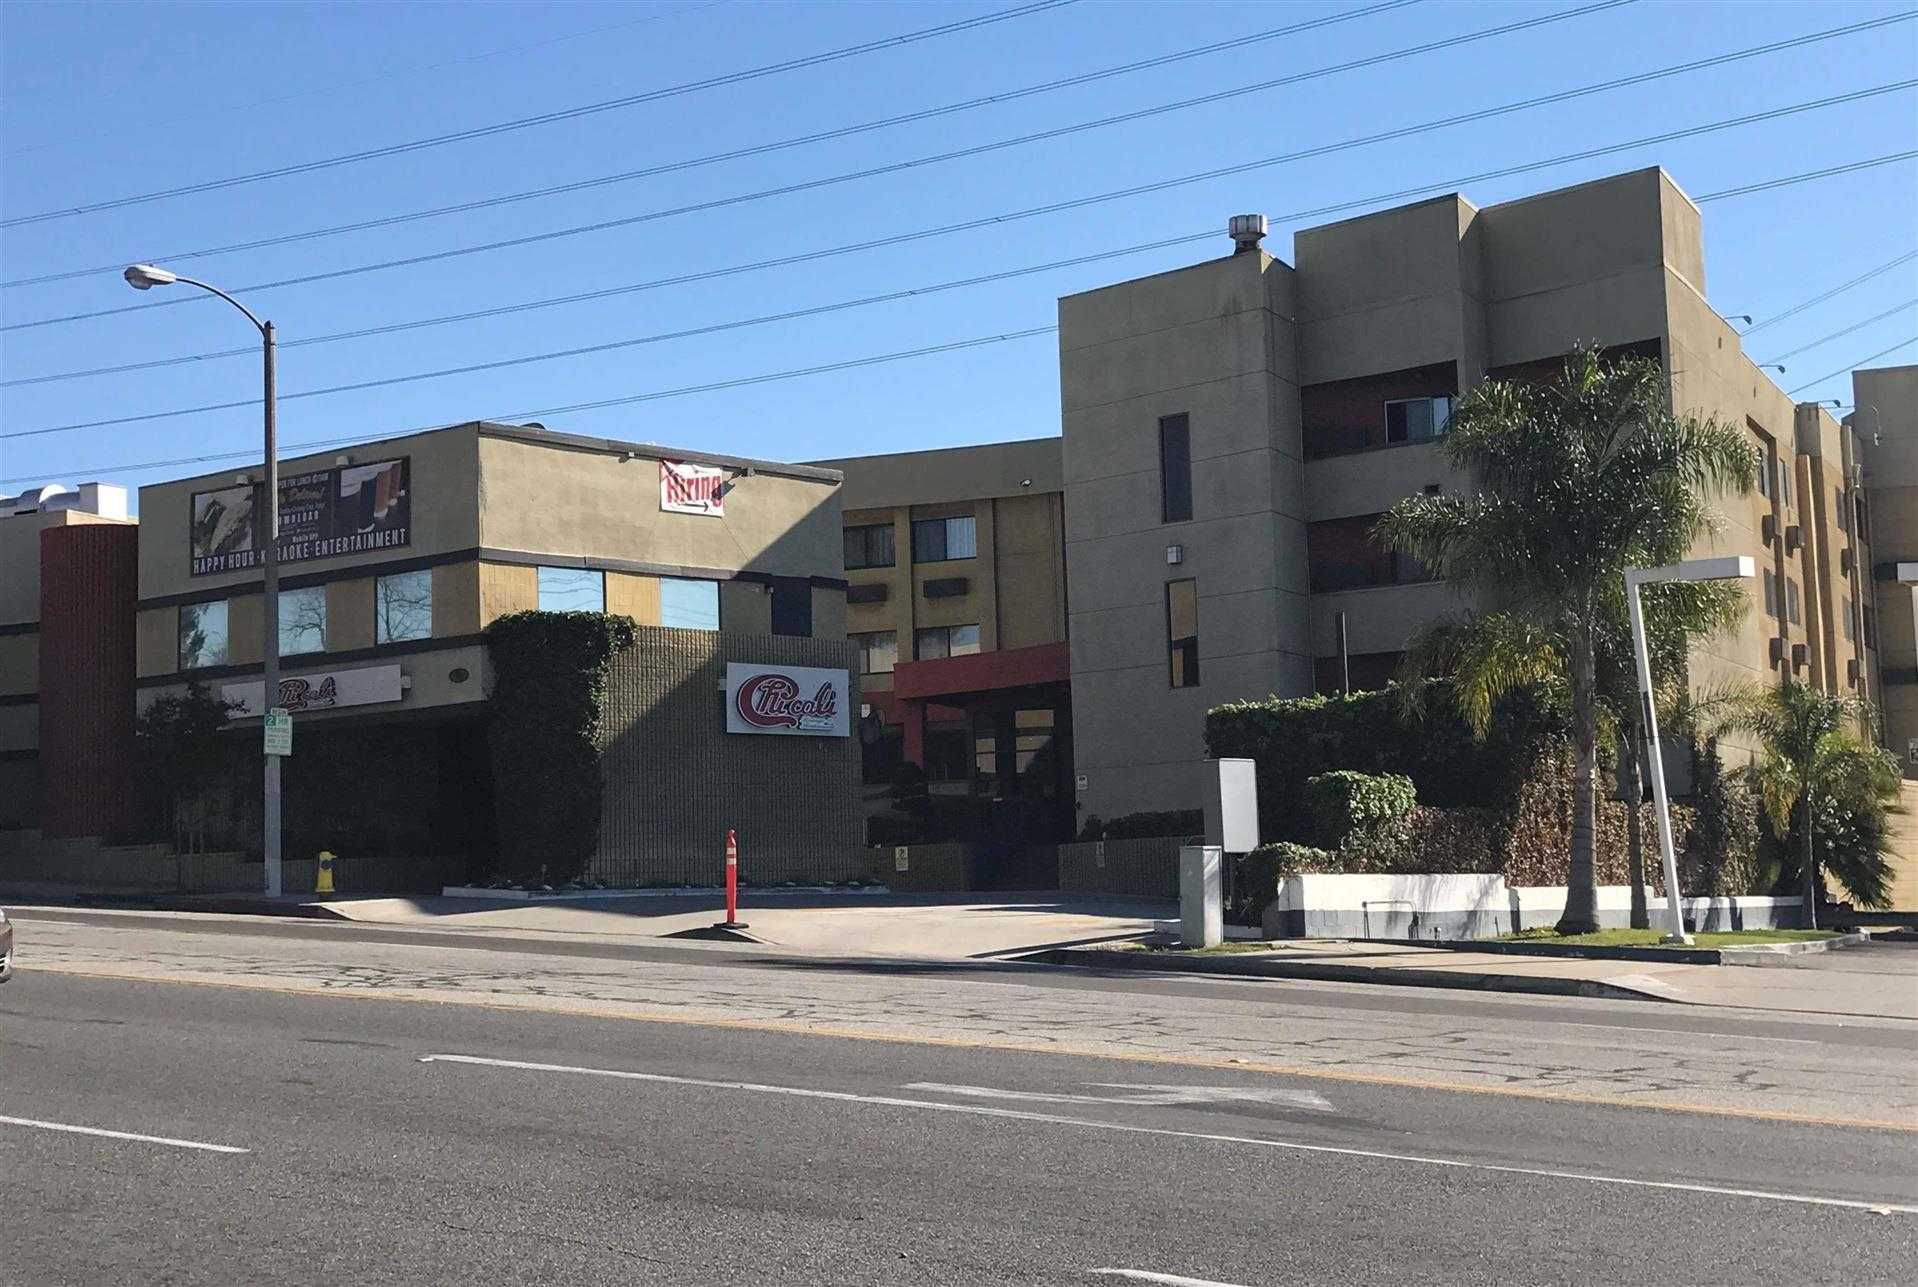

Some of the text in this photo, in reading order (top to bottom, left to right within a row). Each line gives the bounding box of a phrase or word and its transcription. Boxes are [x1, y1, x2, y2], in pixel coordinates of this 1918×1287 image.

[666, 474, 722, 508] Hiring
[278, 510, 319, 526] OWNLOAD
[193, 555, 226, 574] HAPPY
[228, 550, 255, 569] HOUR
[260, 541, 309, 565] KRAOKE
[315, 528, 406, 557] ENTERTAINMENT
[736, 673, 838, 728] Chicali
[267, 716, 274, 726] 2
